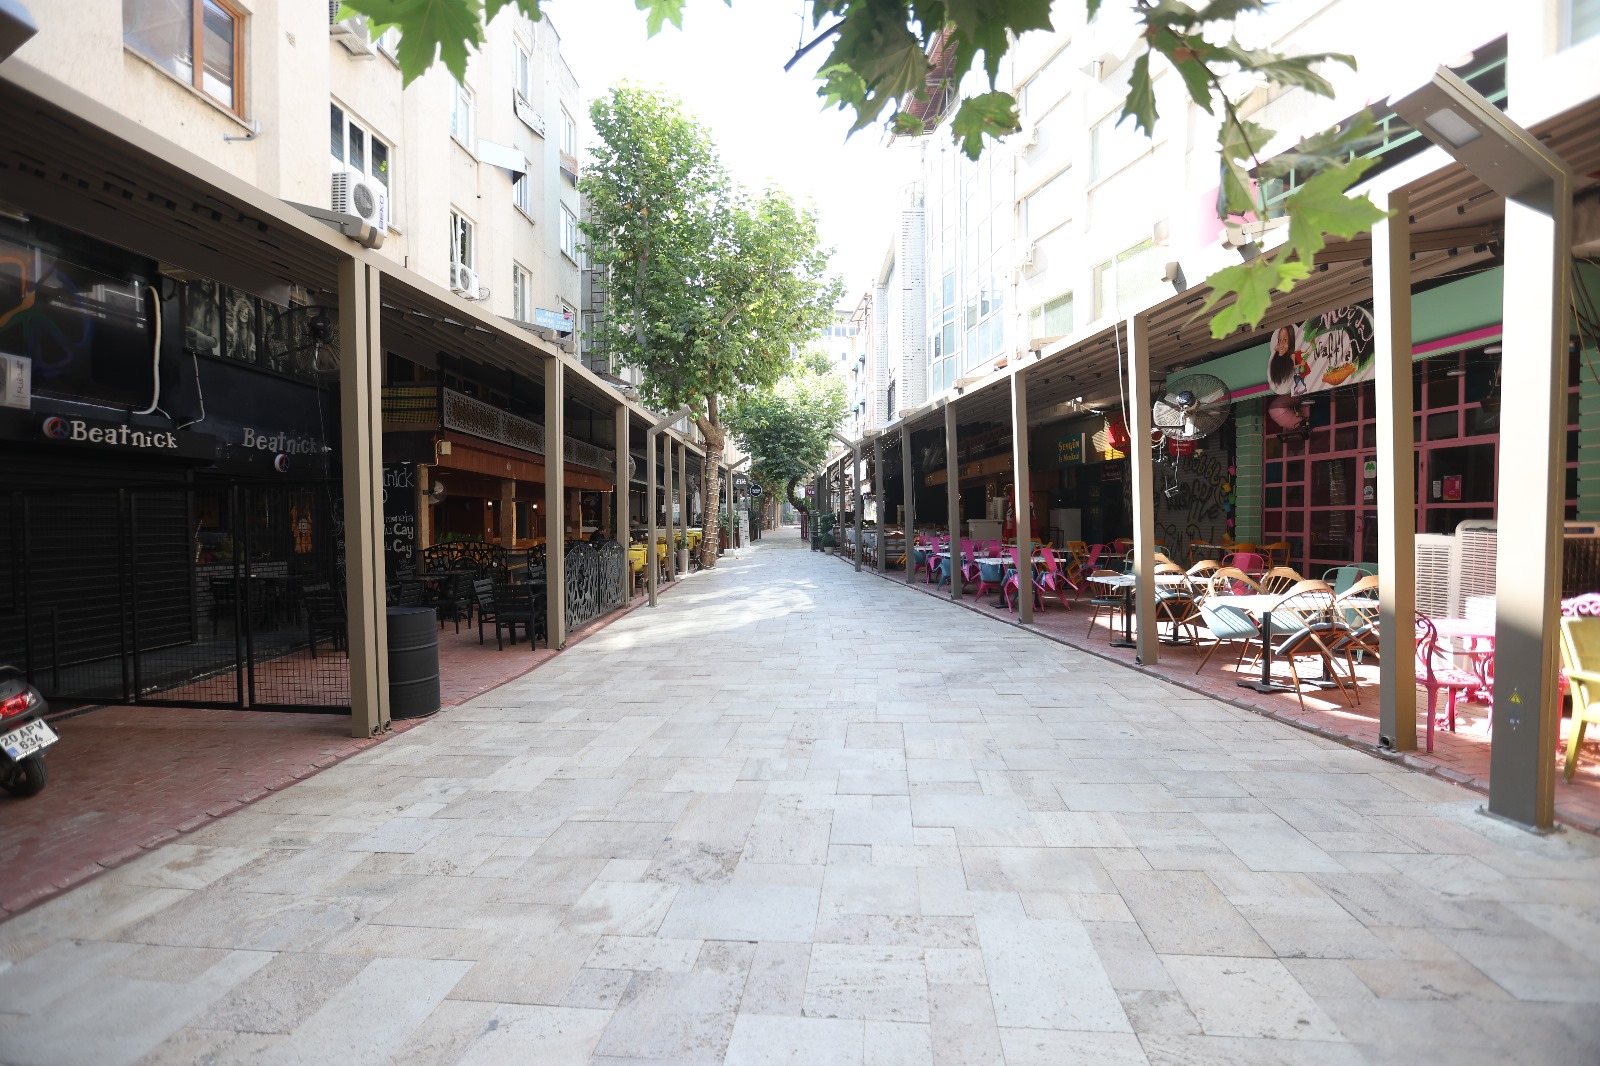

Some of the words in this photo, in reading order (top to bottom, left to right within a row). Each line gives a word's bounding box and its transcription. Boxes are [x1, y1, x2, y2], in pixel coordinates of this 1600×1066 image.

[70, 420, 178, 449] Beatnick
[242, 427, 317, 454] Beatnick
[1, 734, 18, 747] 20
[20, 721, 44, 738] APV
[19, 734, 44, 749] 634
